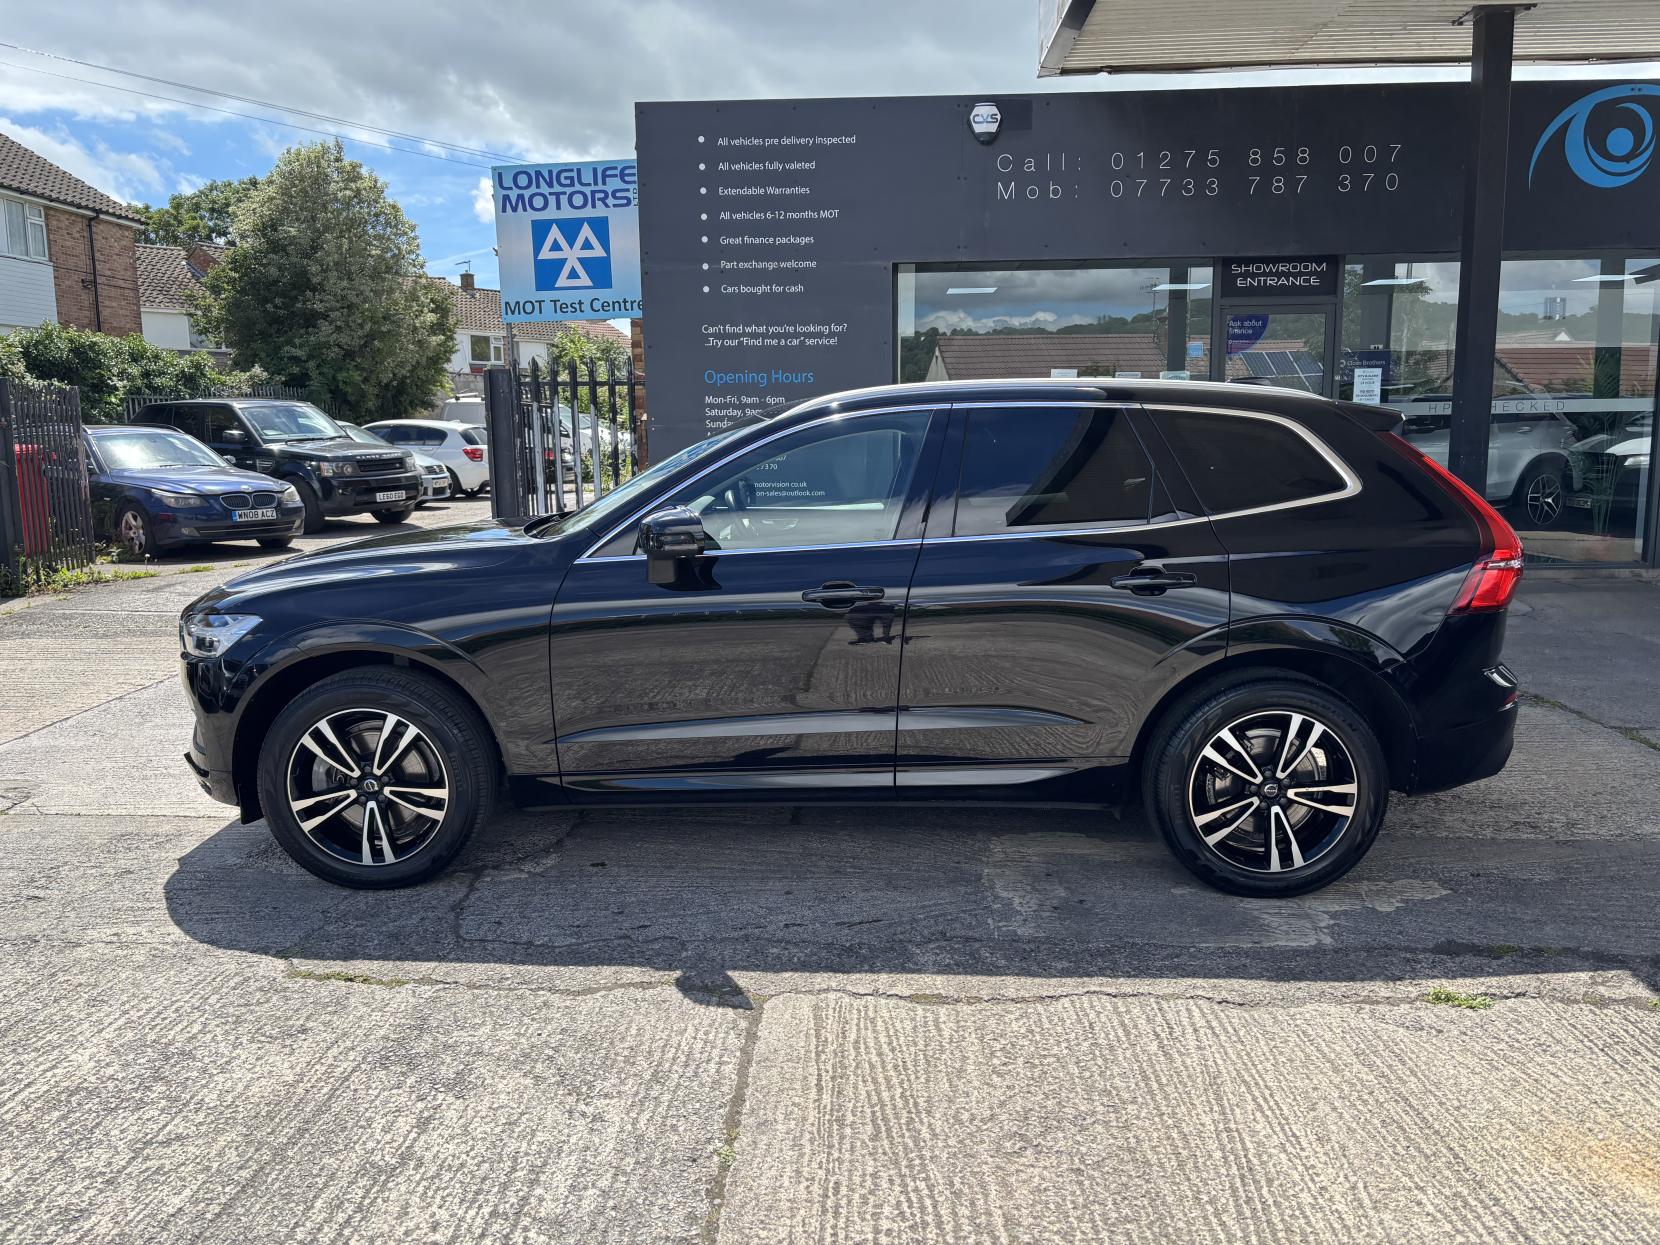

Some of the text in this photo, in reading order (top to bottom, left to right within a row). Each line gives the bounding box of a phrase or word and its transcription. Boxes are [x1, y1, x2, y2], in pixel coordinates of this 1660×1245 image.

[718, 137, 728, 146] All
[730, 136, 763, 146] vehicles
[765, 138, 779, 147] pre
[780, 135, 814, 147] delivery
[997, 144, 1402, 172] Call: 01275 858 007
[718, 160, 816, 172] All vehicles fully valeted
[497, 165, 637, 190] LONGLIFE
[718, 185, 810, 196] Extendable Warranties
[997, 172, 1399, 200] Mob: 07733 787 370
[501, 188, 632, 213] MOTORS
[719, 209, 840, 220] All vehicles 6-12 months MOT
[720, 235, 814, 246] Great finance packages
[720, 259, 817, 270] Part exchange welcome
[1231, 262, 1327, 274] SHOWROOM
[1236, 276, 1320, 287] ENTRANCE
[721, 284, 804, 295] Cars bought for cash
[504, 299, 546, 316] MOT
[550, 298, 585, 314] Test
[701, 323, 848, 335] Can't find what you're looking for?
[723, 338, 739, 346] our
[764, 338, 778, 346] me
[805, 337, 838, 345] service!
[704, 369, 814, 387] Opening Hours
[705, 395, 739, 405] Mon-Fri,
[740, 395, 760, 404] 9am
[766, 395, 786, 405] 6pm
[705, 407, 744, 418] Saturday,
[1428, 400, 1565, 414] HP HECKED
[705, 417, 734, 428] Sunda
[237, 509, 276, 520] WN08 ACZ
